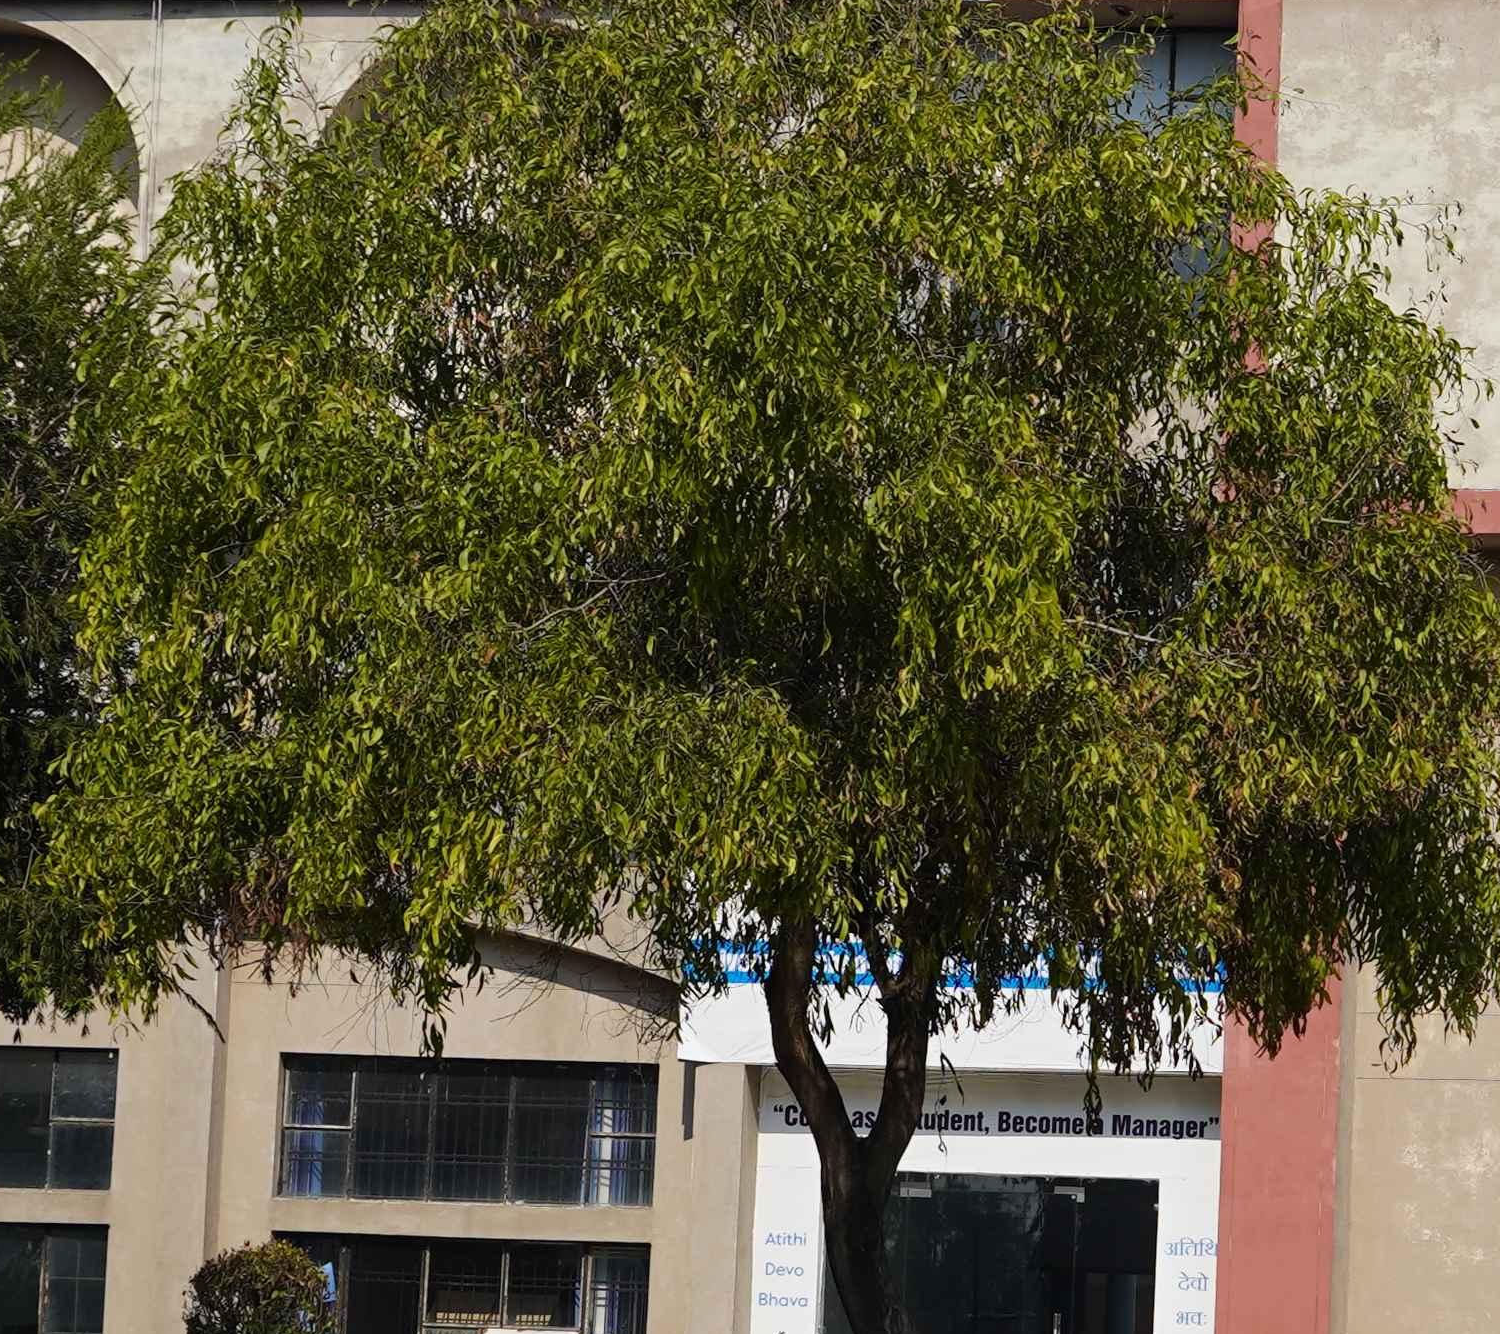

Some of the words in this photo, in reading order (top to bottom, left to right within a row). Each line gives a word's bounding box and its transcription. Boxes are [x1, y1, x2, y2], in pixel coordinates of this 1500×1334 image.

[916, 1110, 990, 1135] tudent,
[998, 1111, 1084, 1135] Become
[765, 1232, 807, 1246] Atithi
[1164, 1236, 1219, 1257] अतिथि
[765, 1261, 805, 1277] Devo
[1178, 1270, 1209, 1292] देवो
[758, 1292, 809, 1308] Bhava
